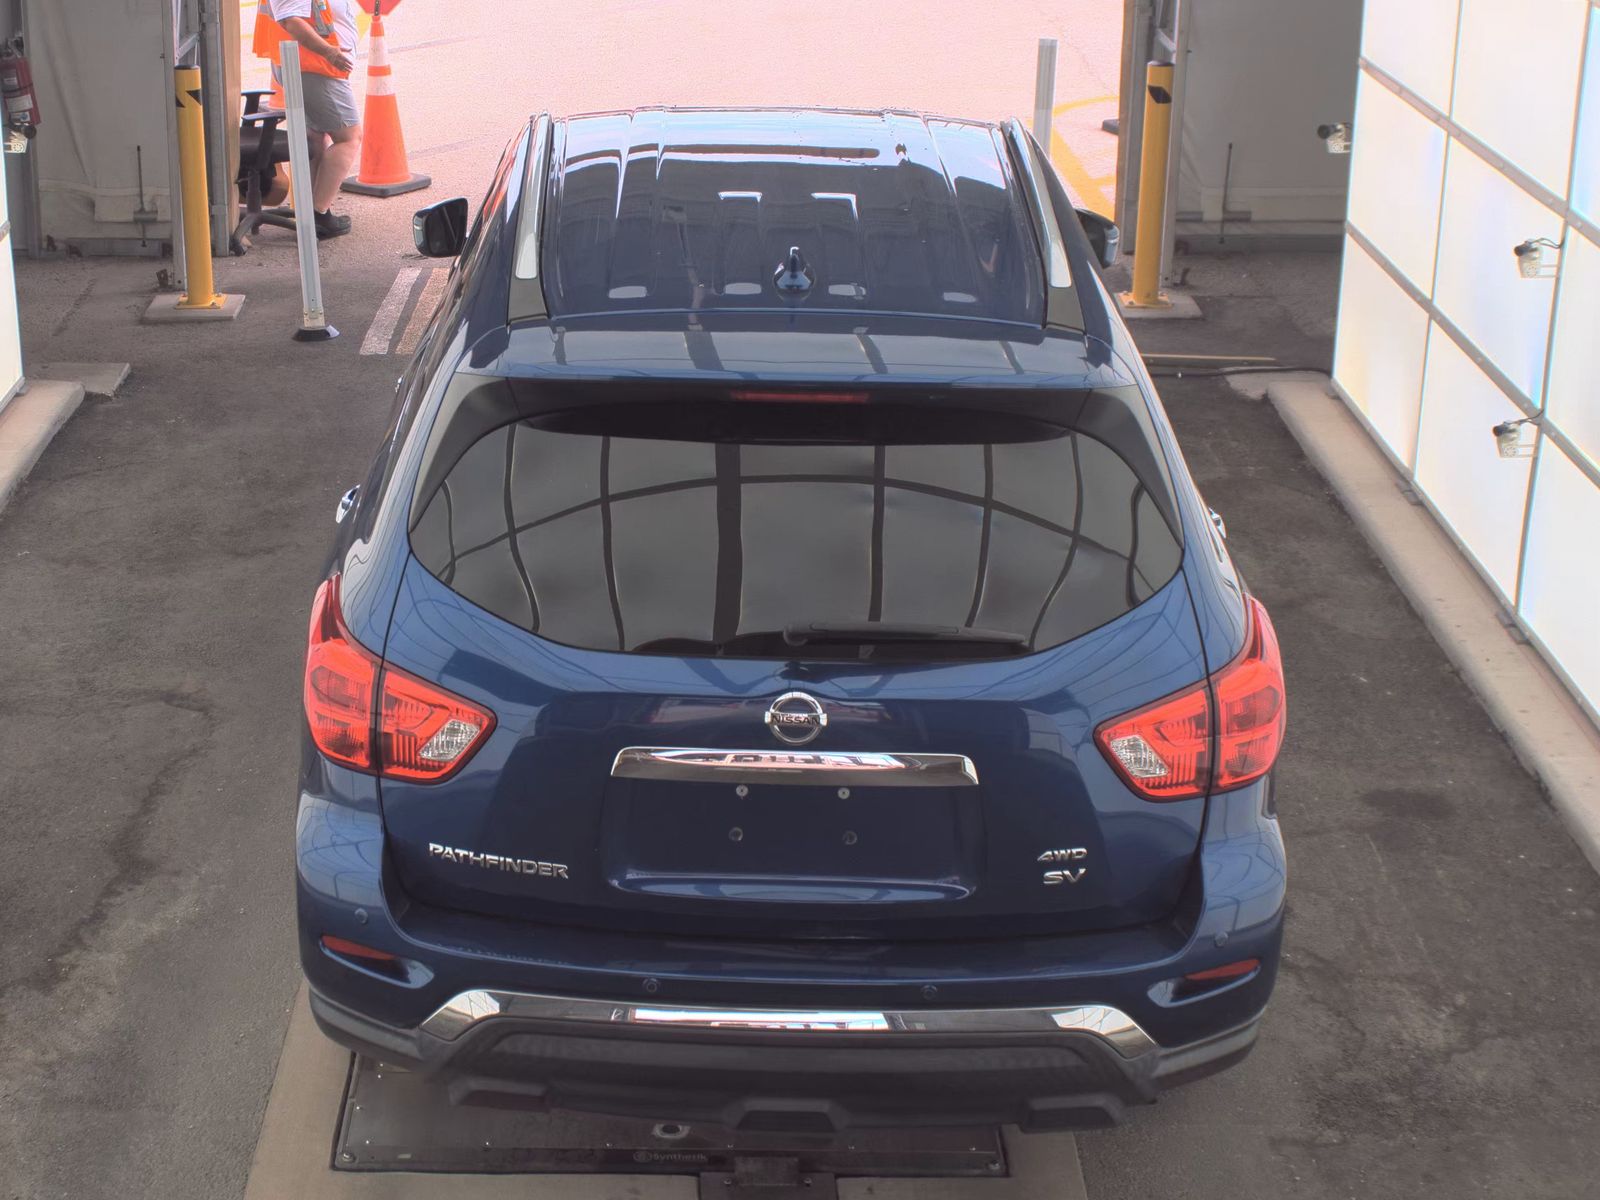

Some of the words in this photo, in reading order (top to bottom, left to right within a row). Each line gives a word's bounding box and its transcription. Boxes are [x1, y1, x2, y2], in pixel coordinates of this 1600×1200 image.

[771, 714, 820, 726] NISSAN
[428, 842, 569, 879] PATHFINDER
[1037, 847, 1088, 862] 4WD
[1043, 867, 1087, 885] SV
